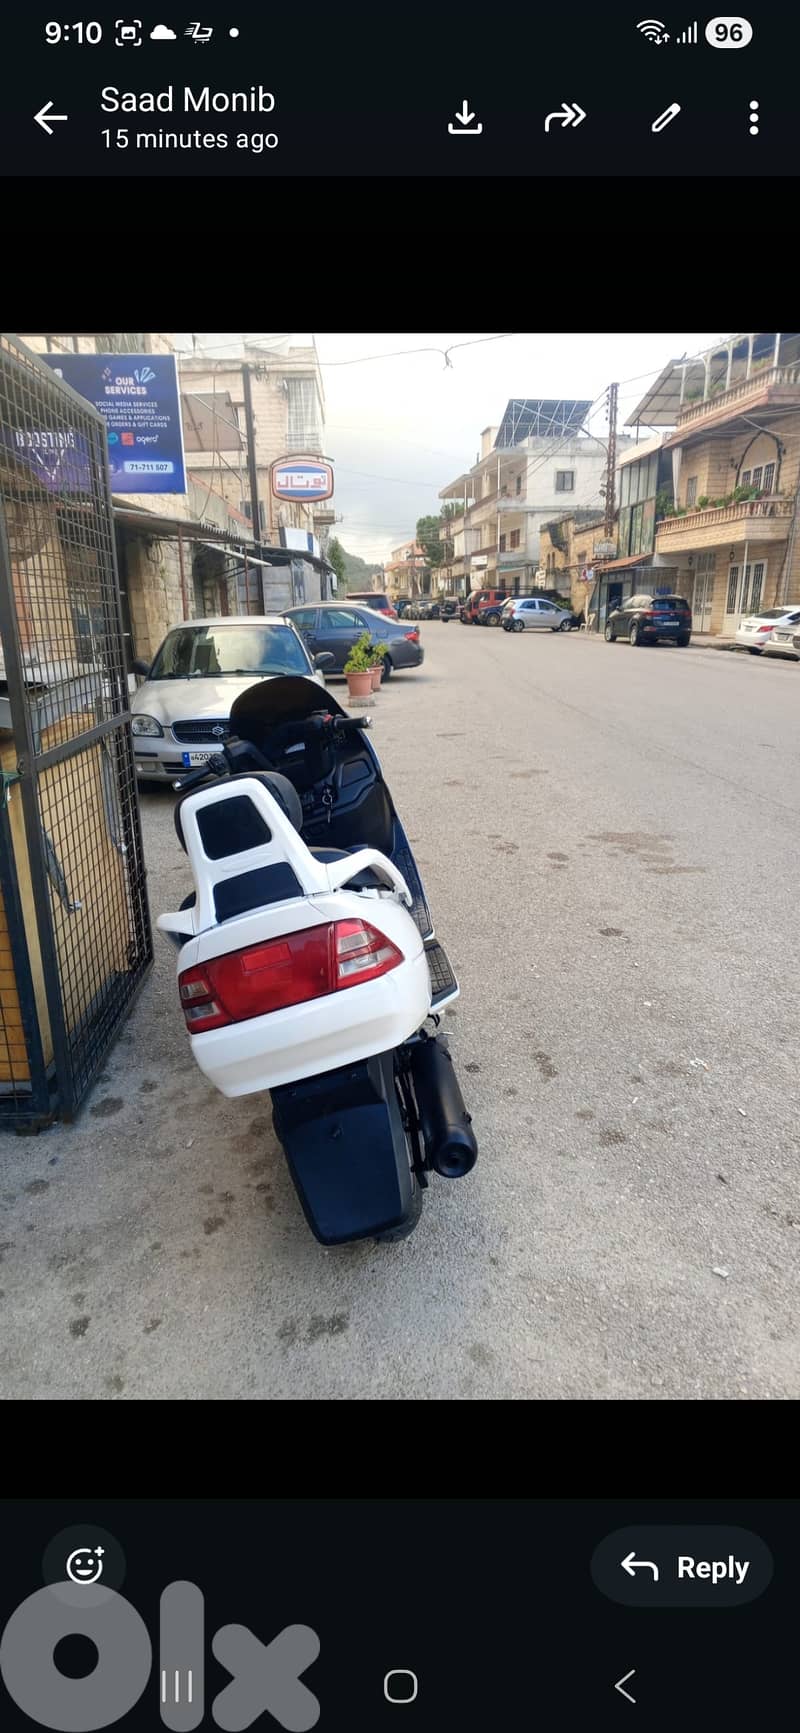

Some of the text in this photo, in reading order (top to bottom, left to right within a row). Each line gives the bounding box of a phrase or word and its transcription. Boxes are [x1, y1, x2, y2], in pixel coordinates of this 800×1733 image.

[115, 377, 134, 386] OUR
[105, 386, 148, 395] SERVICES
[278, 474, 326, 488] توتال
